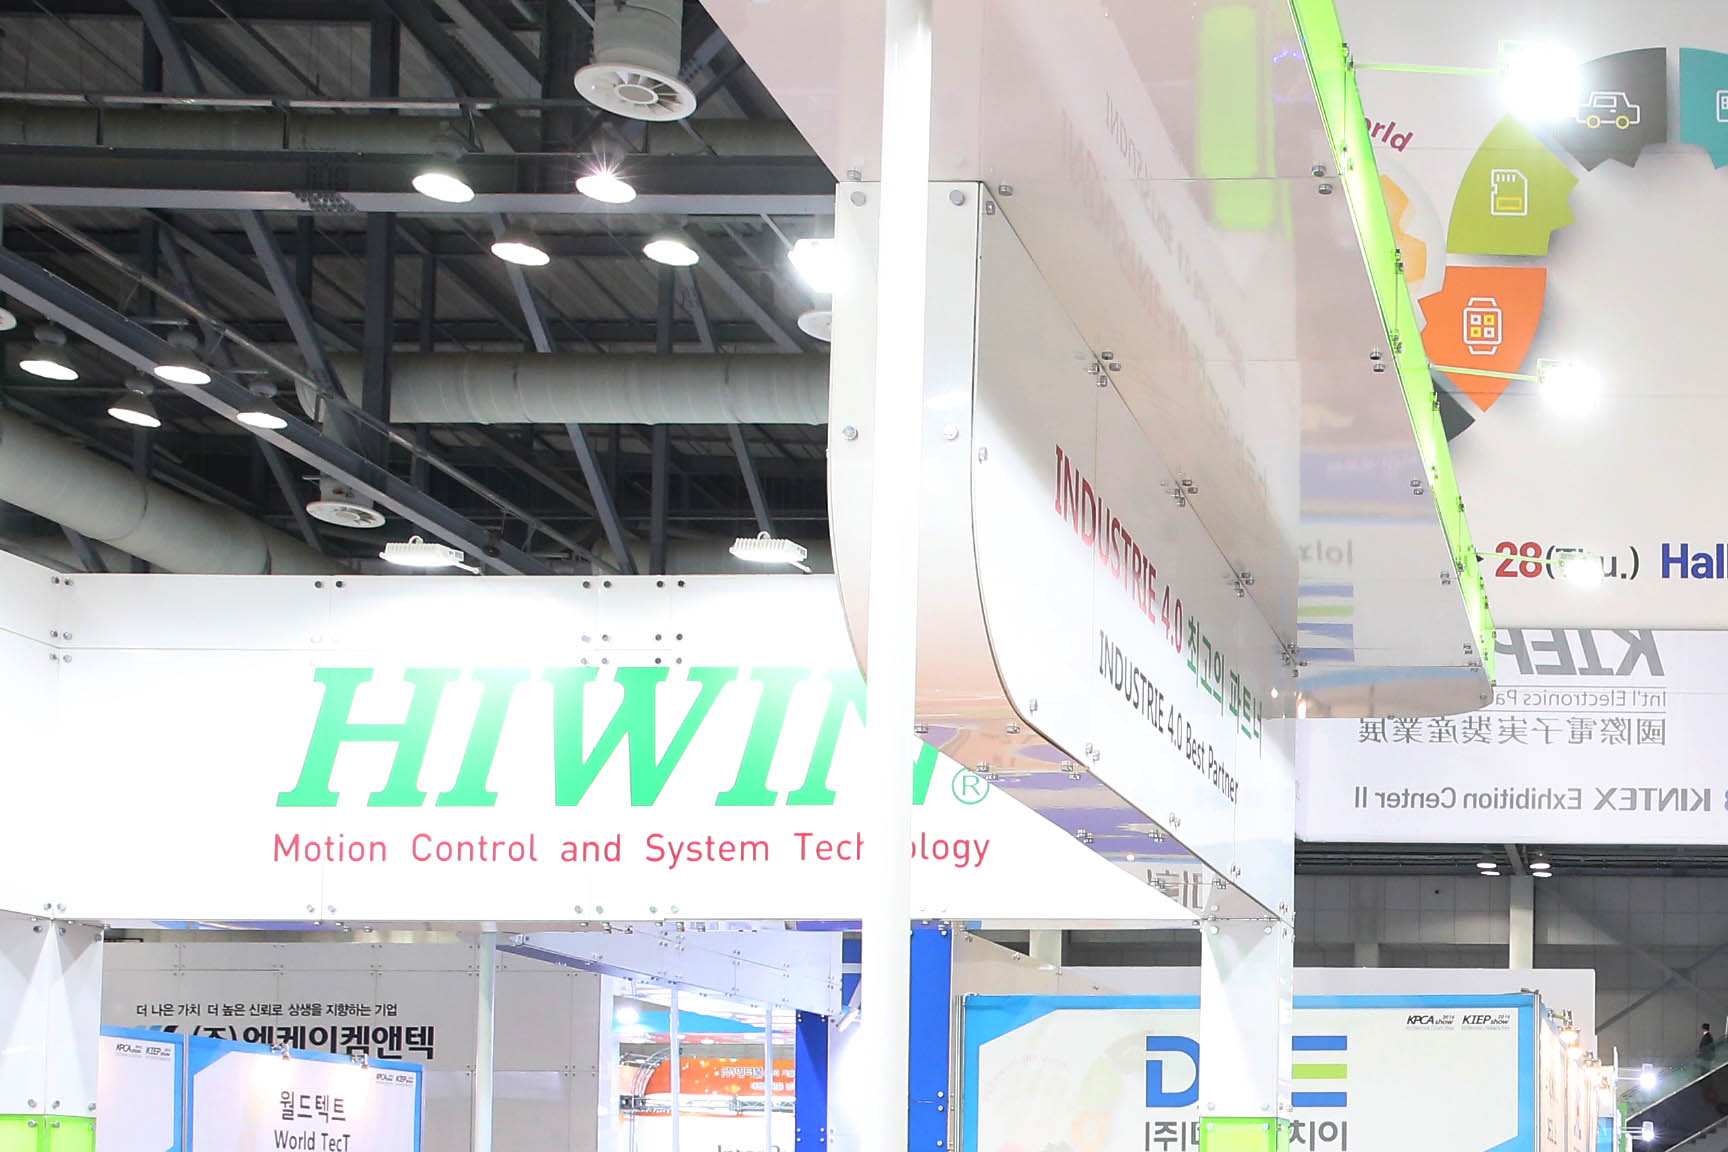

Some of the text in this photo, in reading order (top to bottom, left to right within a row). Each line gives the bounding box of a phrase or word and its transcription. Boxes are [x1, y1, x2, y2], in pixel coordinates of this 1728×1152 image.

[1365, 117, 1413, 152] orld
[1055, 445, 1263, 760] INDUSTRIE 4.0 최고의 파트너
[1099, 628, 1239, 806] INDUSTRIE 4.0 Best Partner
[273, 832, 990, 870] Motion Control and System Techlogy
[137, 1003, 397, 1017] 더 나은 가치 더 높은 신뢰로 상생을 지향하는 기업
[1146, 1035, 1347, 1107] DE
[279, 1089, 346, 1123] 월드텍트
[274, 1129, 351, 1152] World TecT
